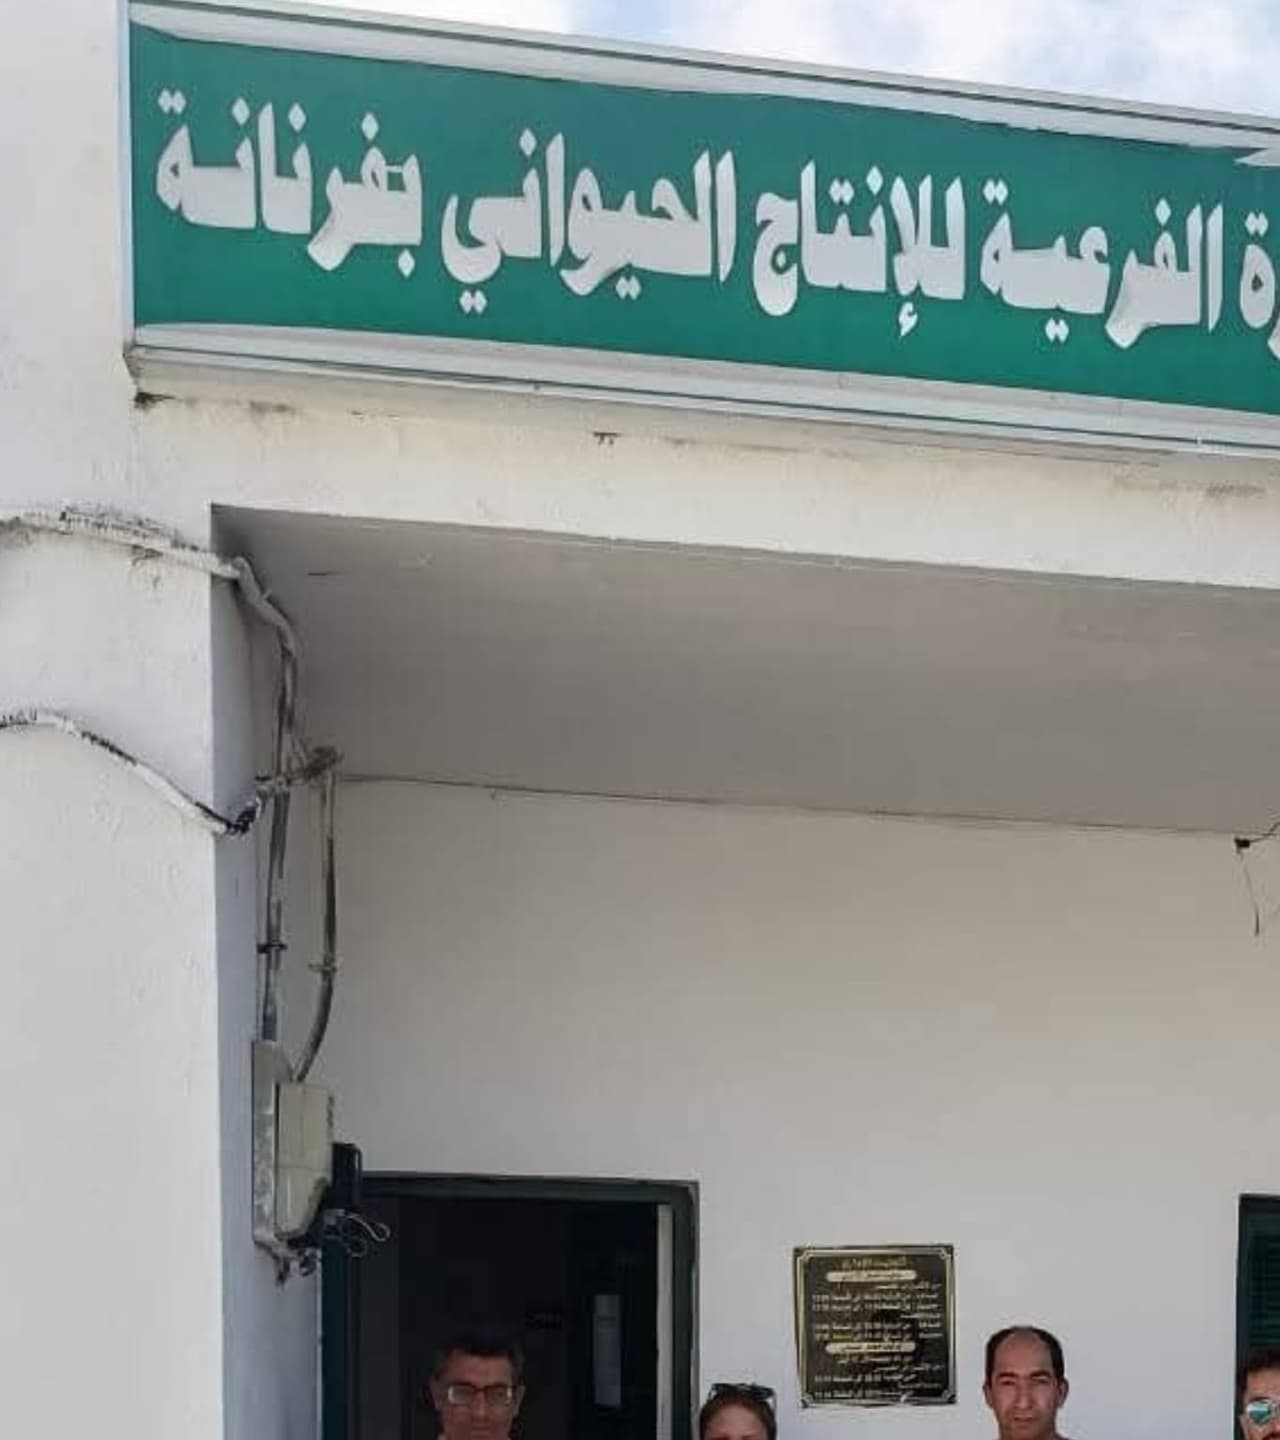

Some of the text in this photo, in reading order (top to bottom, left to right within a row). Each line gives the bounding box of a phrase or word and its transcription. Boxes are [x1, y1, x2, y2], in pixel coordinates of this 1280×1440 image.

[156, 88, 423, 277] بفرنانة
[441, 127, 737, 314] الحيواني
[752, 160, 966, 337] للإنتاج
[979, 179, 1224, 349] الفرعية
